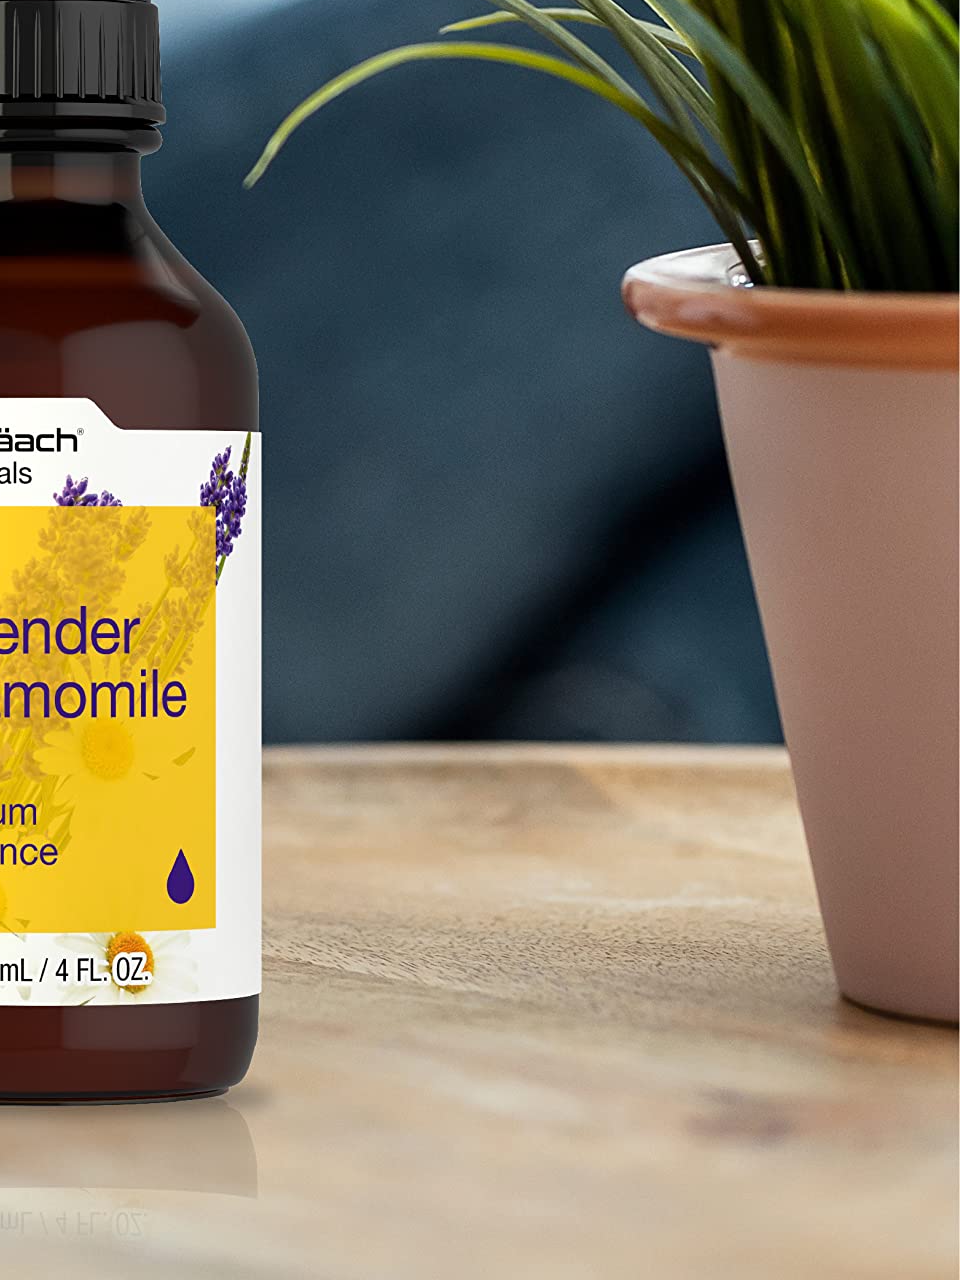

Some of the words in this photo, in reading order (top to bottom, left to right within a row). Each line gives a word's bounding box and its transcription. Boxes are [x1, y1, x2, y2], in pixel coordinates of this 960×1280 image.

[0, 956, 33, 982] mL
[38, 956, 49, 983] /
[55, 957, 69, 982] 4
[76, 957, 109, 982] FL.
[116, 956, 150, 982] OZ.
